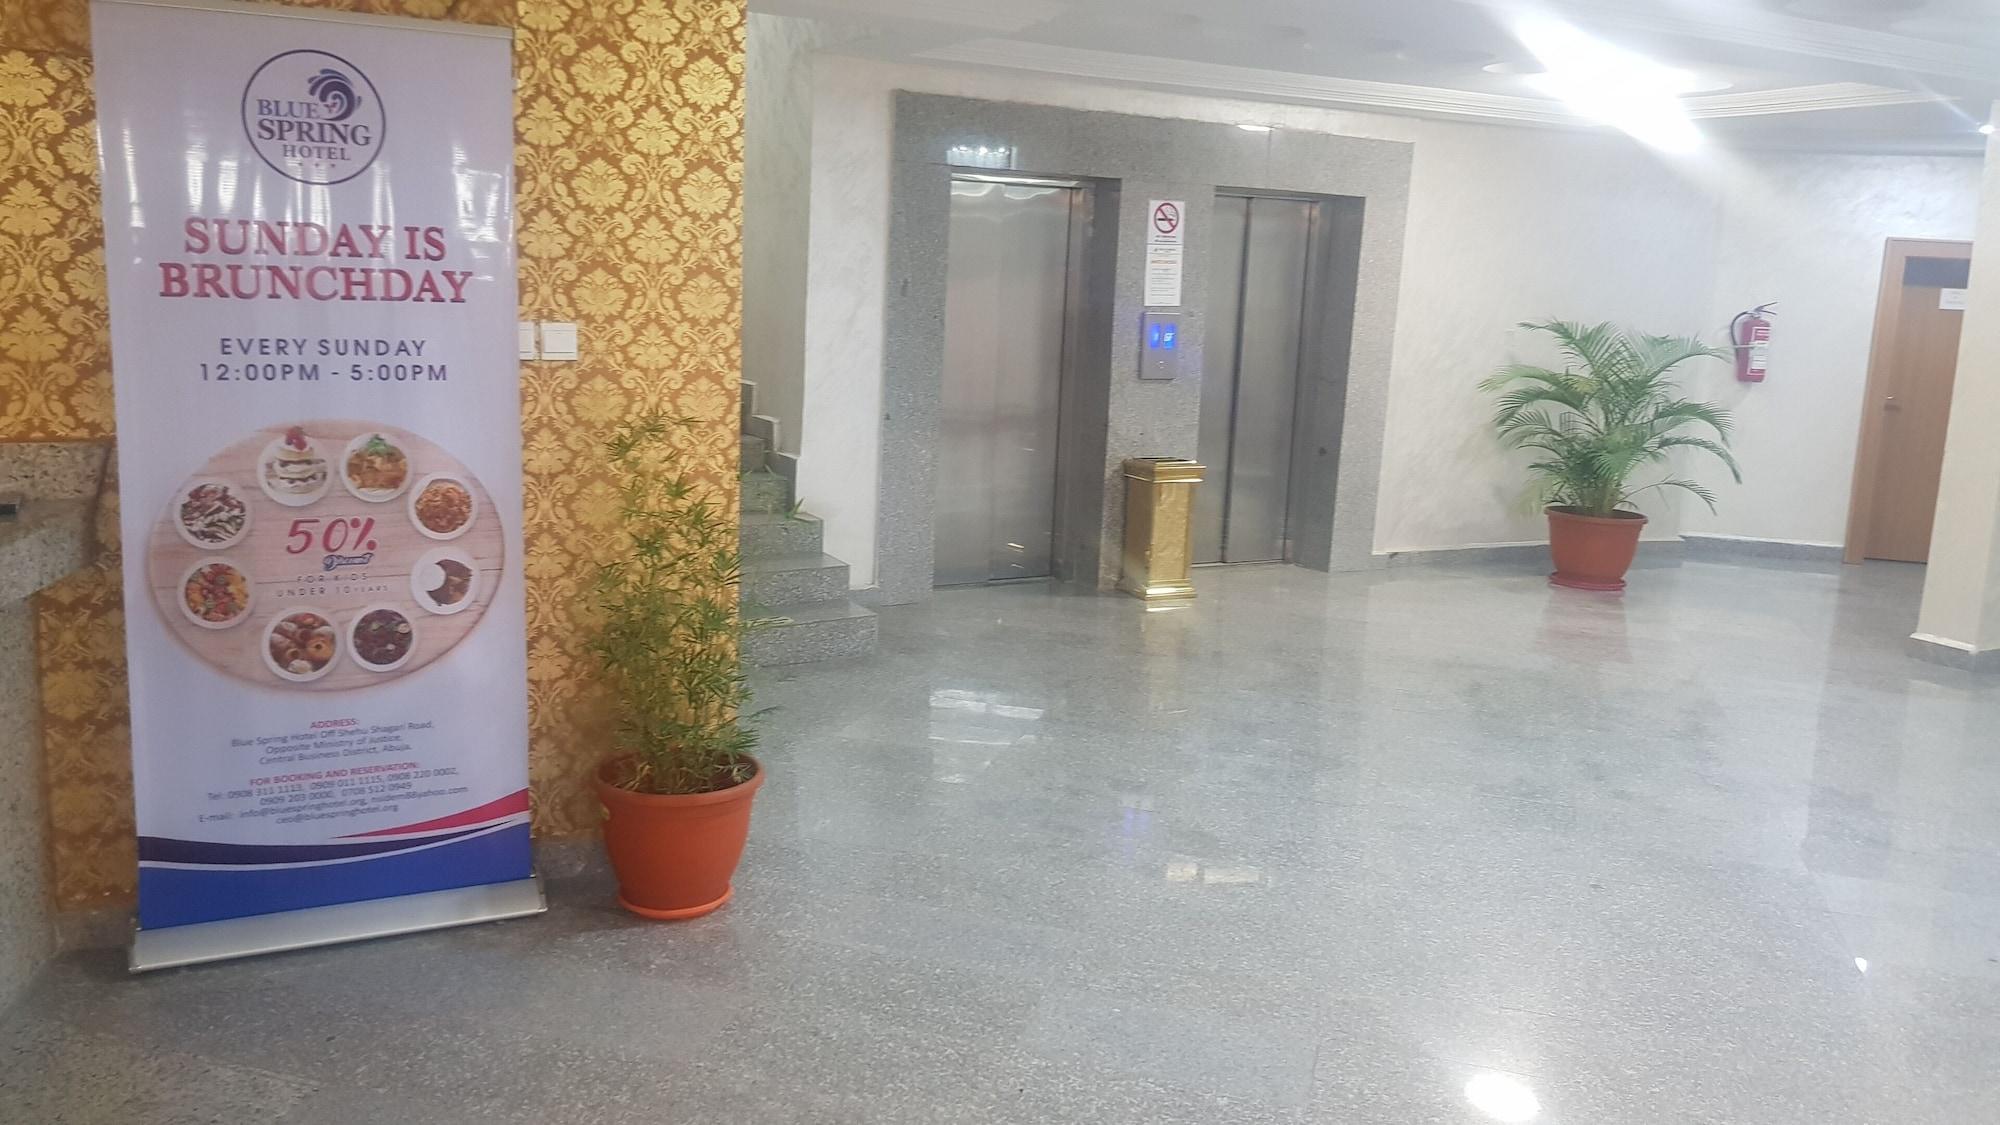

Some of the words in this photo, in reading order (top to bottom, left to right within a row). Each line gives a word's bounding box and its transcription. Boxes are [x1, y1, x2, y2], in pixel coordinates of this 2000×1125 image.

[256, 99, 322, 119] BLUE
[257, 118, 372, 146] SPRING
[282, 144, 351, 161] HOTEL
[184, 216, 392, 259] SUNDAY
[404, 226, 448, 261] IS
[159, 262, 473, 303] BRUNCHDAY
[220, 338, 307, 355] EVERY
[317, 338, 426, 357] SUNDAY
[200, 363, 320, 381] 12:00PM
[350, 364, 448, 381] 5:00PM
[285, 517, 378, 554] 50%
[297, 575, 325, 584] FOR
[276, 586, 326, 598] UNDER
[310, 718, 359, 729] ADDRESS:
[256, 735, 288, 746] Spring
[265, 743, 312, 755] Opposite
[313, 739, 354, 750] Ministry
[356, 736, 367, 746] of
[259, 755, 294, 766] Central
[297, 751, 340, 762] Business
[249, 777, 271, 787] FOR
[272, 771, 323, 784] BOOKING
[324, 768, 348, 778] AND
